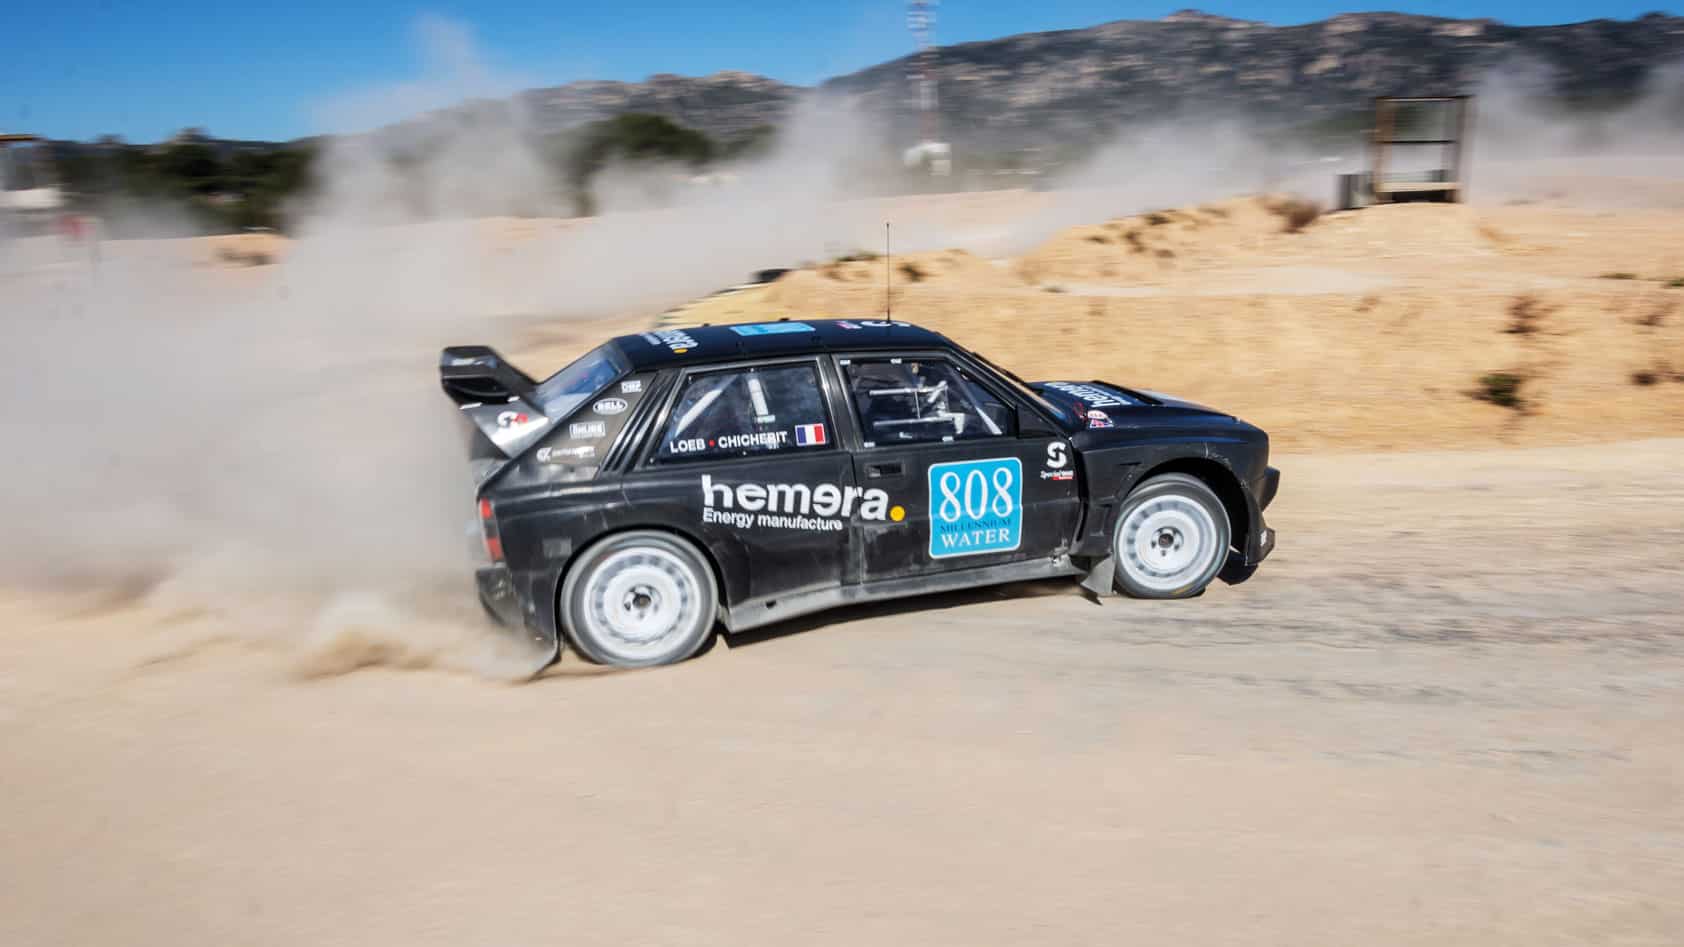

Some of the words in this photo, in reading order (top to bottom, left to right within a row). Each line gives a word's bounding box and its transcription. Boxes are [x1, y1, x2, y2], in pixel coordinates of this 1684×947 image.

[670, 438, 706, 453] LOEB
[940, 467, 1014, 523] 808
[703, 507, 754, 528] Energy
[757, 513, 844, 531] manufacture
[941, 528, 1011, 549] WATER
